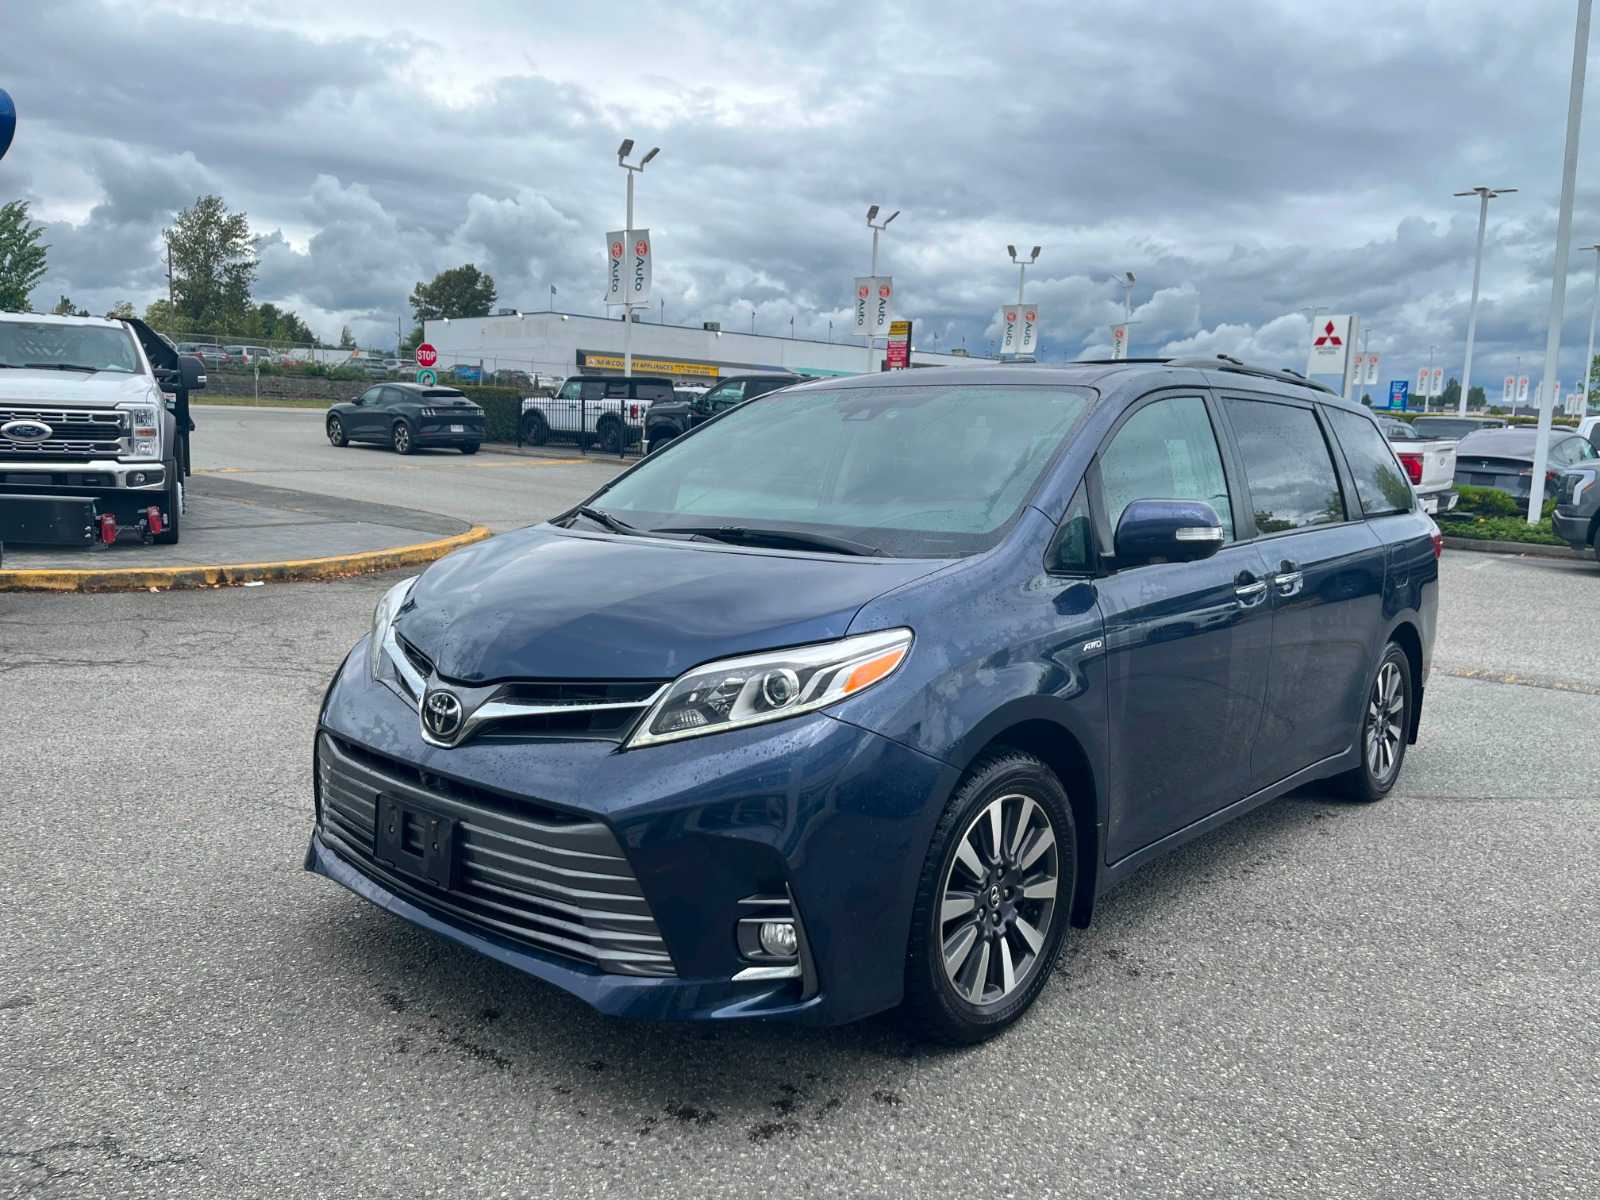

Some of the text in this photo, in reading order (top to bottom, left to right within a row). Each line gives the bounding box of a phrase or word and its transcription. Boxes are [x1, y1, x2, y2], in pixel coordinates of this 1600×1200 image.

[612, 259, 620, 292] Auto
[635, 256, 645, 291] Auto
[858, 299, 866, 326] Auto
[878, 298, 887, 325] Auto
[1006, 323, 1014, 345] Auto
[1024, 321, 1033, 345] Auto
[417, 350, 436, 361] STOP
[596, 358, 611, 367] NEW
[612, 360, 639, 369] COURY
[640, 361, 673, 371] APPLIANCES
[1083, 640, 1102, 651] AWD
